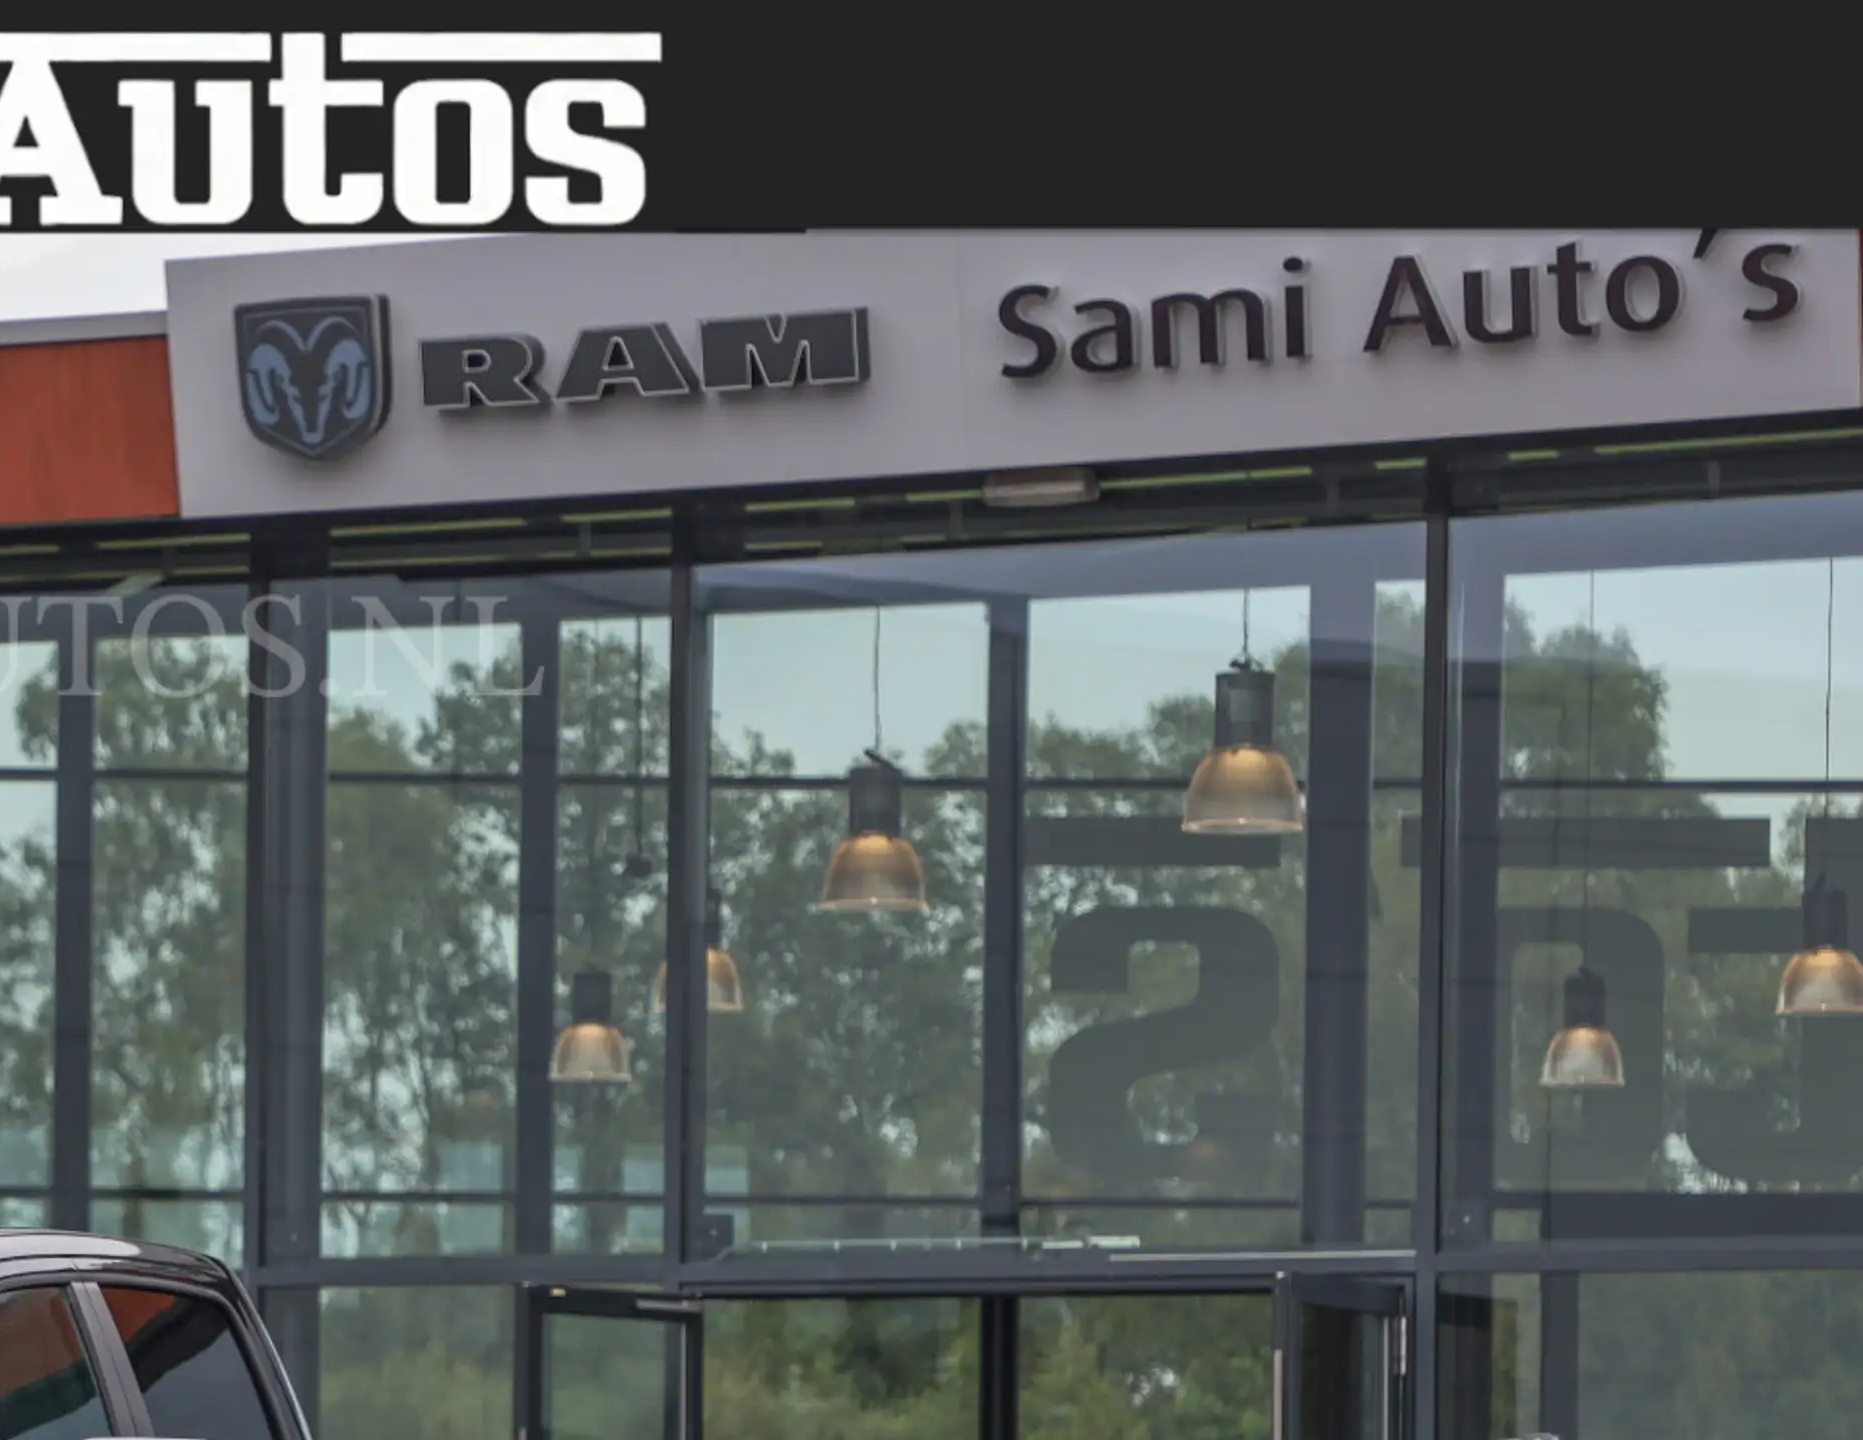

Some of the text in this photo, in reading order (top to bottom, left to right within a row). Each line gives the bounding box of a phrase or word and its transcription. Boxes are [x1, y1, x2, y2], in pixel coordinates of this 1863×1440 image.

[418, 306, 870, 410] RAM
[997, 228, 1801, 379] Sami Auto's
